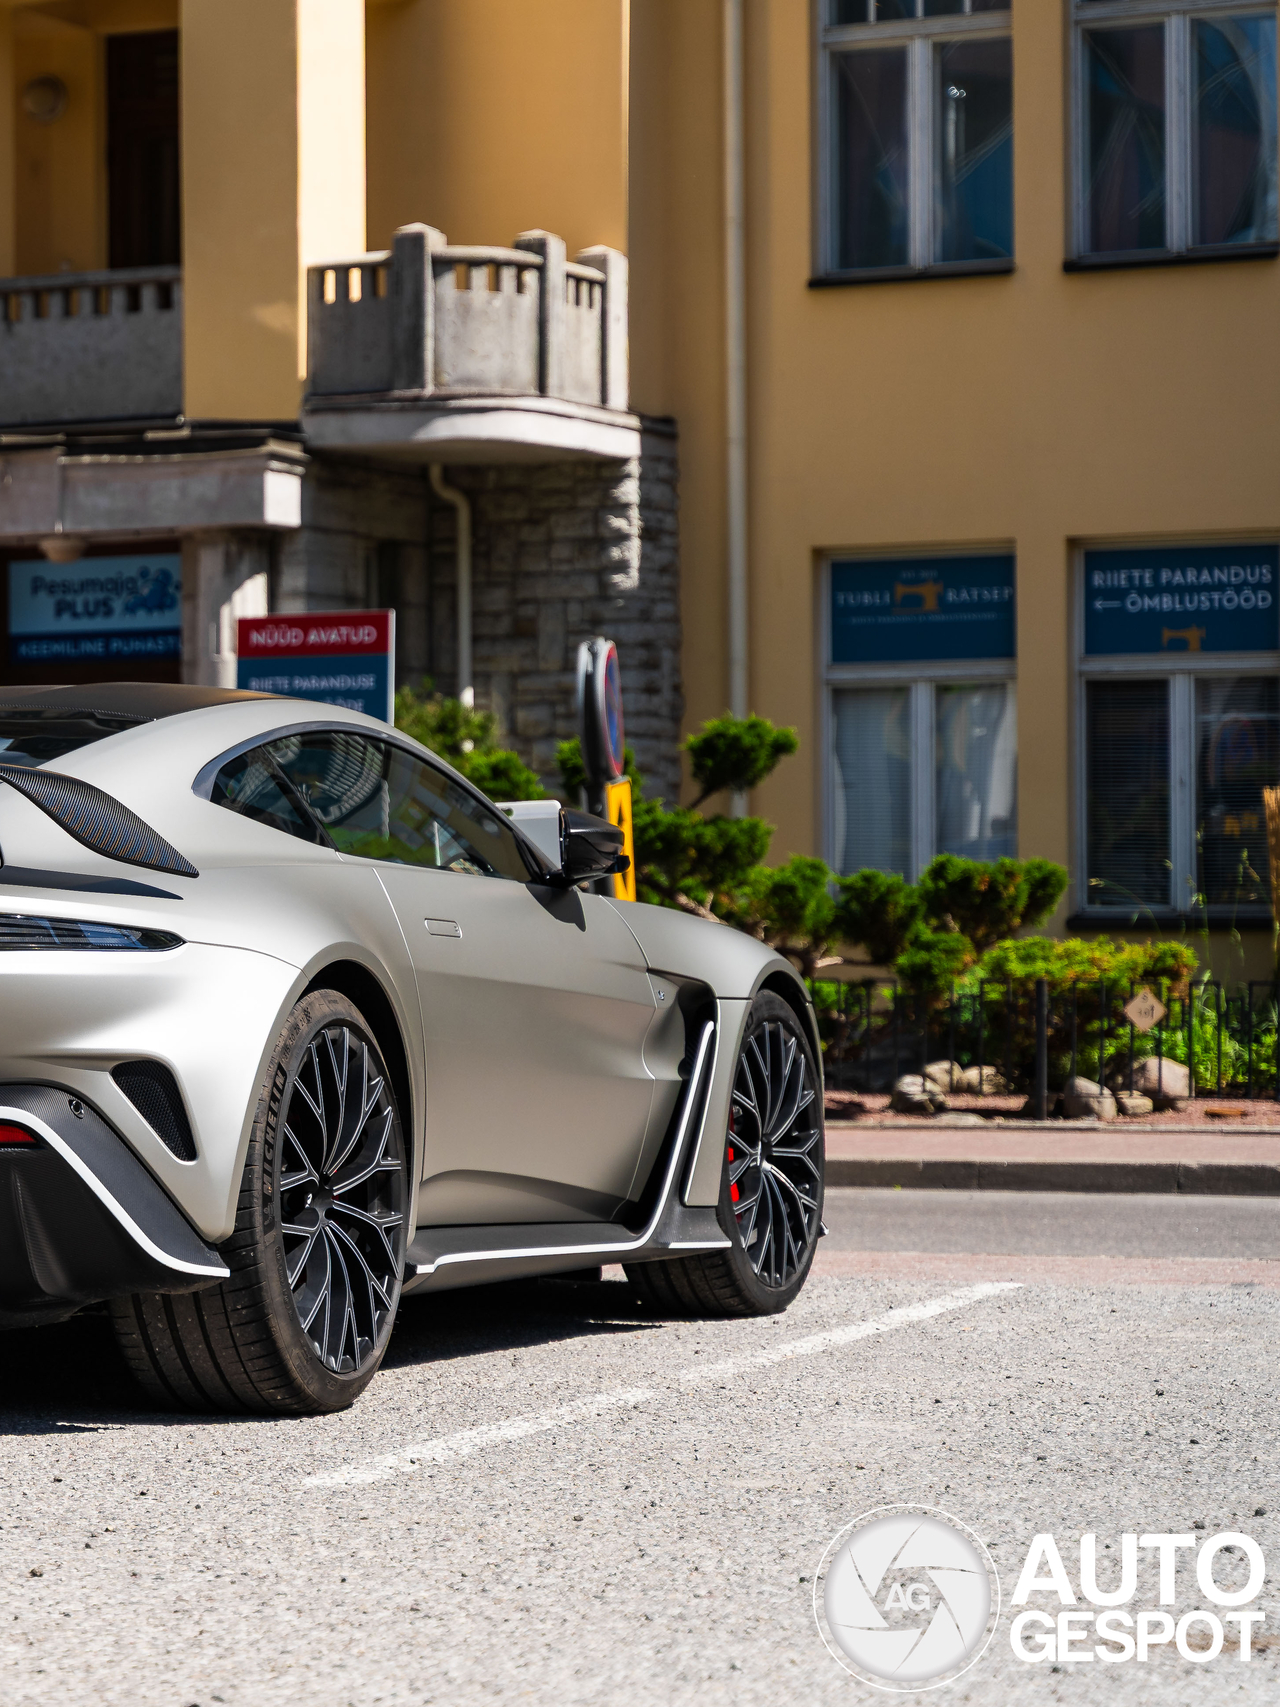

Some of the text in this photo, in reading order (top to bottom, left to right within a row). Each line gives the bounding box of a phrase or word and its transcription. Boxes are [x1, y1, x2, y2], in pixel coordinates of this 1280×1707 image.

[1092, 565, 1272, 589] RIIETE PARANDUS
[54, 597, 115, 619] PLUS
[1126, 587, 1272, 613] ÕMBLUSTÖÖD
[249, 624, 377, 647] NÜÜD AVATUD
[263, 1067, 286, 1197] MICHELIN
